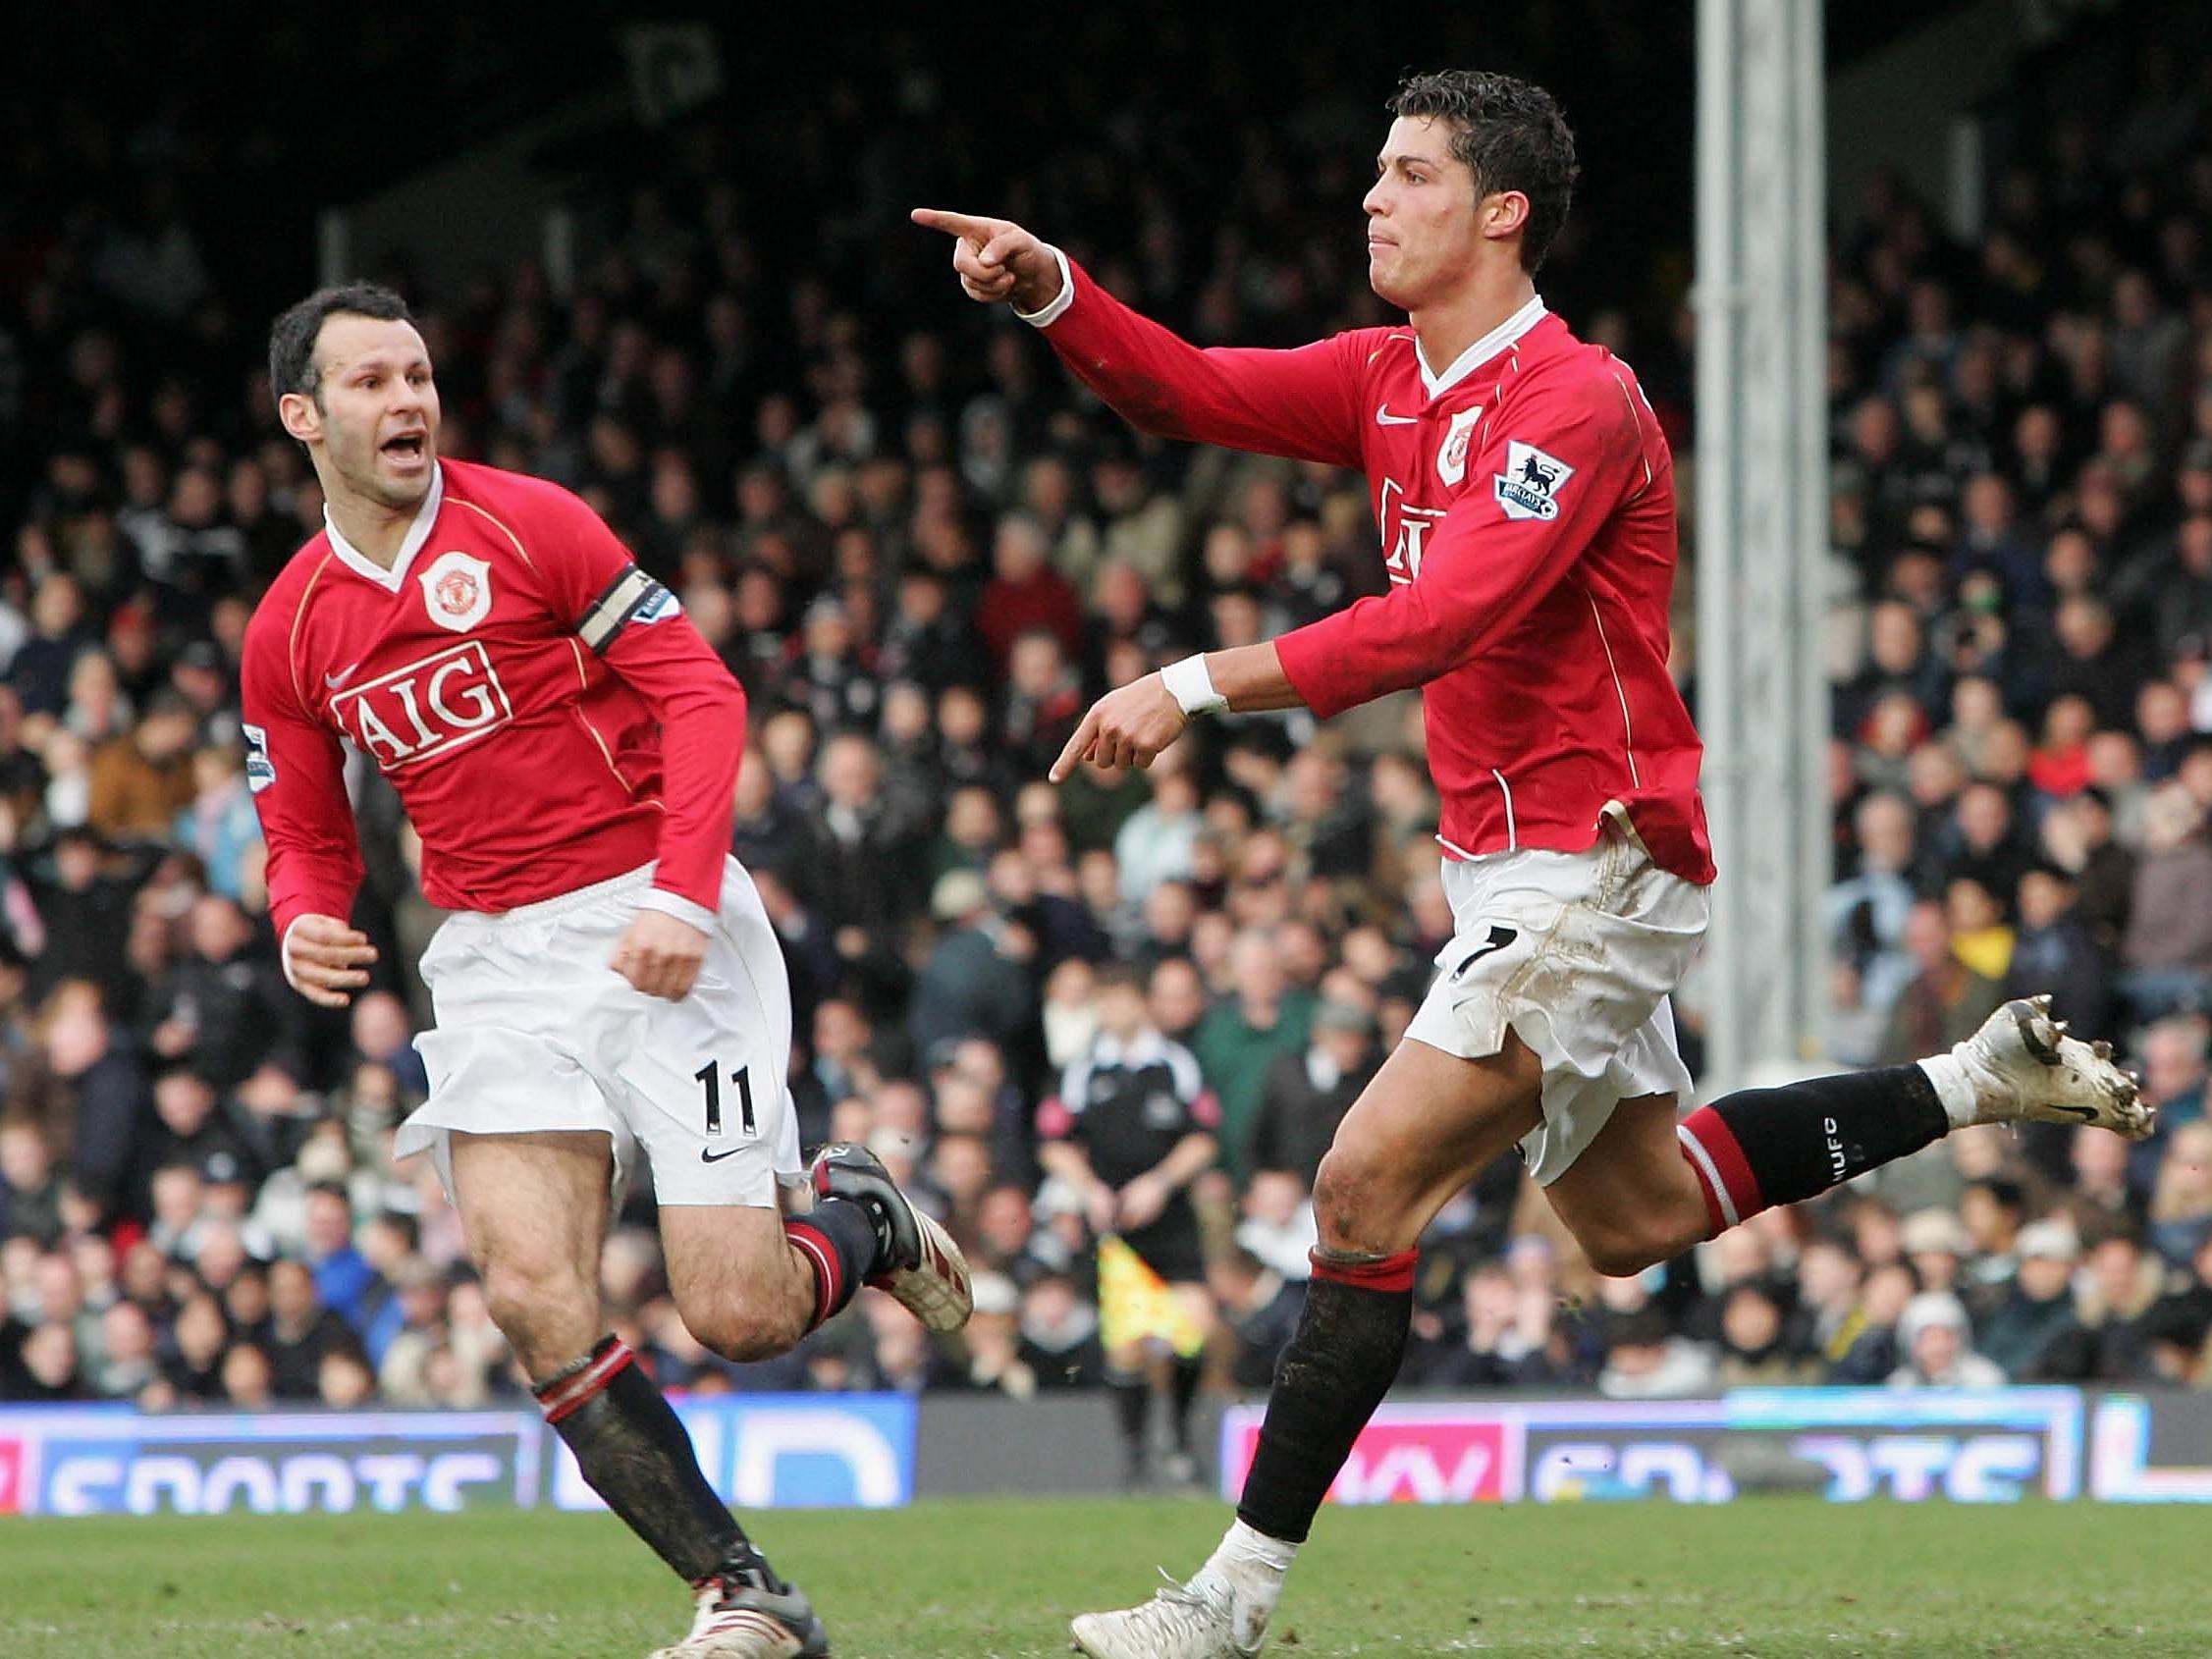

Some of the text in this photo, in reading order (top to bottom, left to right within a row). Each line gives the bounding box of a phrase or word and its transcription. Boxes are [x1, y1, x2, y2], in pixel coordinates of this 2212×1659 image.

[1385, 518, 1431, 580] AI
[357, 657, 498, 760] AIG
[1448, 926, 1518, 983] 7
[694, 1059, 758, 1138] 11
